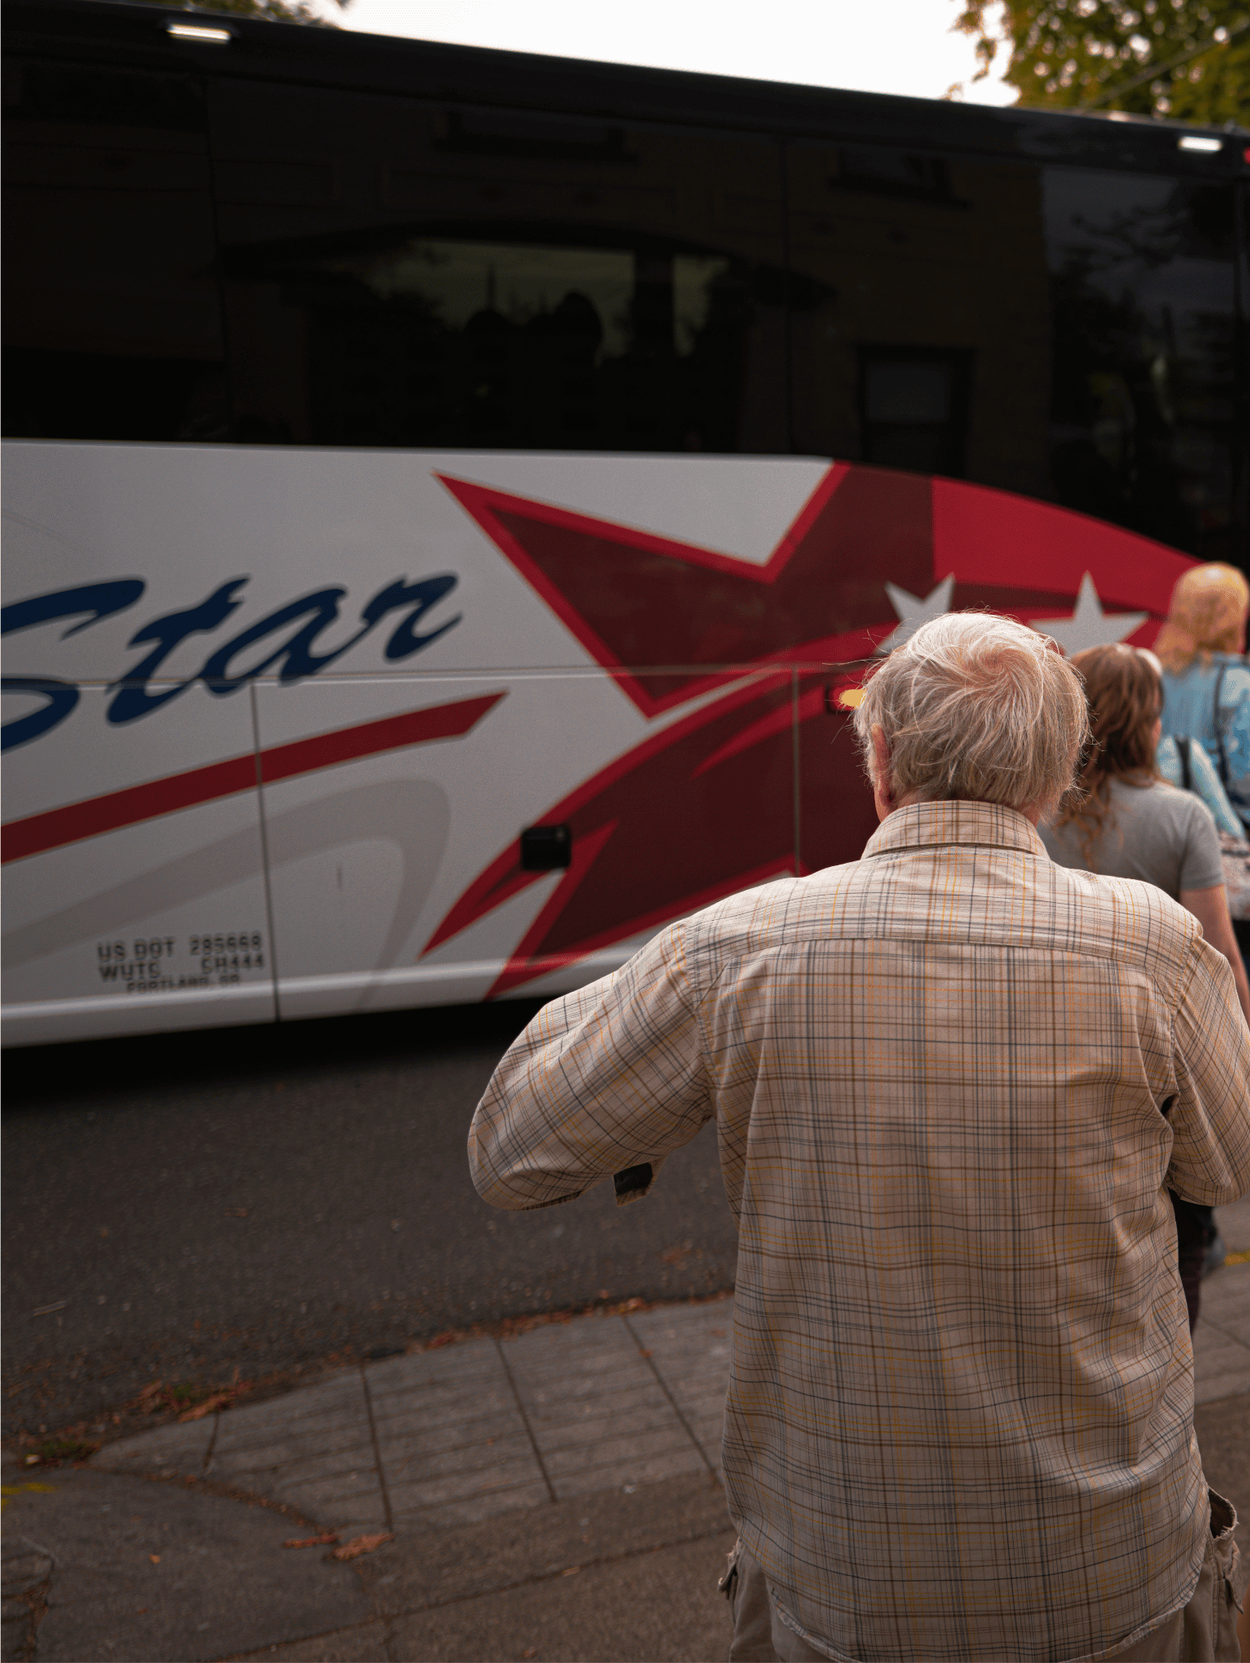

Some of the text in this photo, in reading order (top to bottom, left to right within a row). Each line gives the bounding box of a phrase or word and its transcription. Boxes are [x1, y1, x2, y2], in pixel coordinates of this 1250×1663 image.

[0, 572, 463, 756] Star
[97, 940, 126, 963] US
[133, 936, 175, 961] DOT
[98, 961, 161, 983] WUTC
